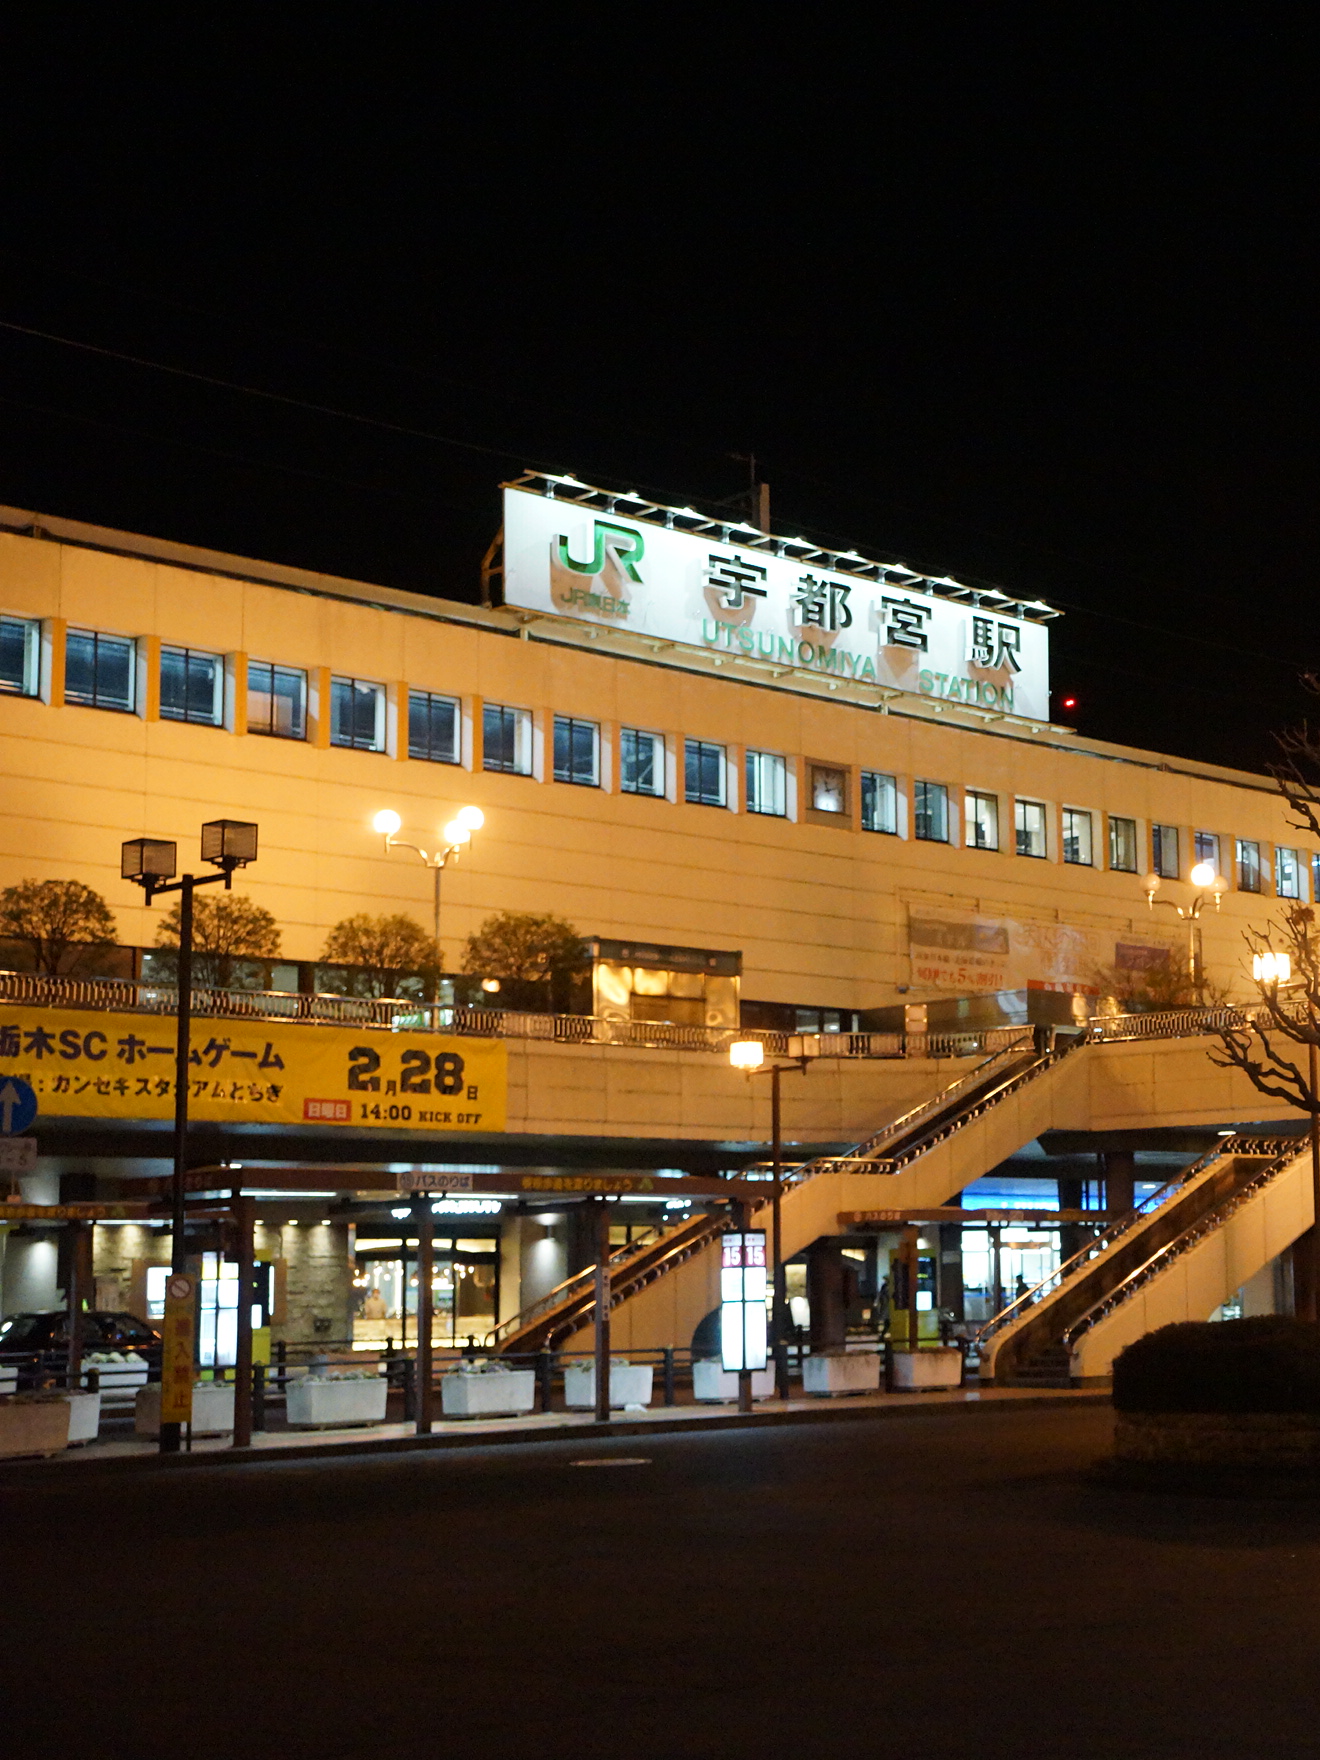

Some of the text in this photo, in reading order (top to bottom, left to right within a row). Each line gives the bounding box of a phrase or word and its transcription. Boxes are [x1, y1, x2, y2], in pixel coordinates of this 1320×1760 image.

[551, 519, 645, 585] JR
[703, 553, 1022, 674] 宇都宮駅
[701, 617, 1015, 711] UTSUNOMIYA STATION
[360, 1104, 412, 1121] 14:00
[723, 1246, 764, 1266] 15 15
